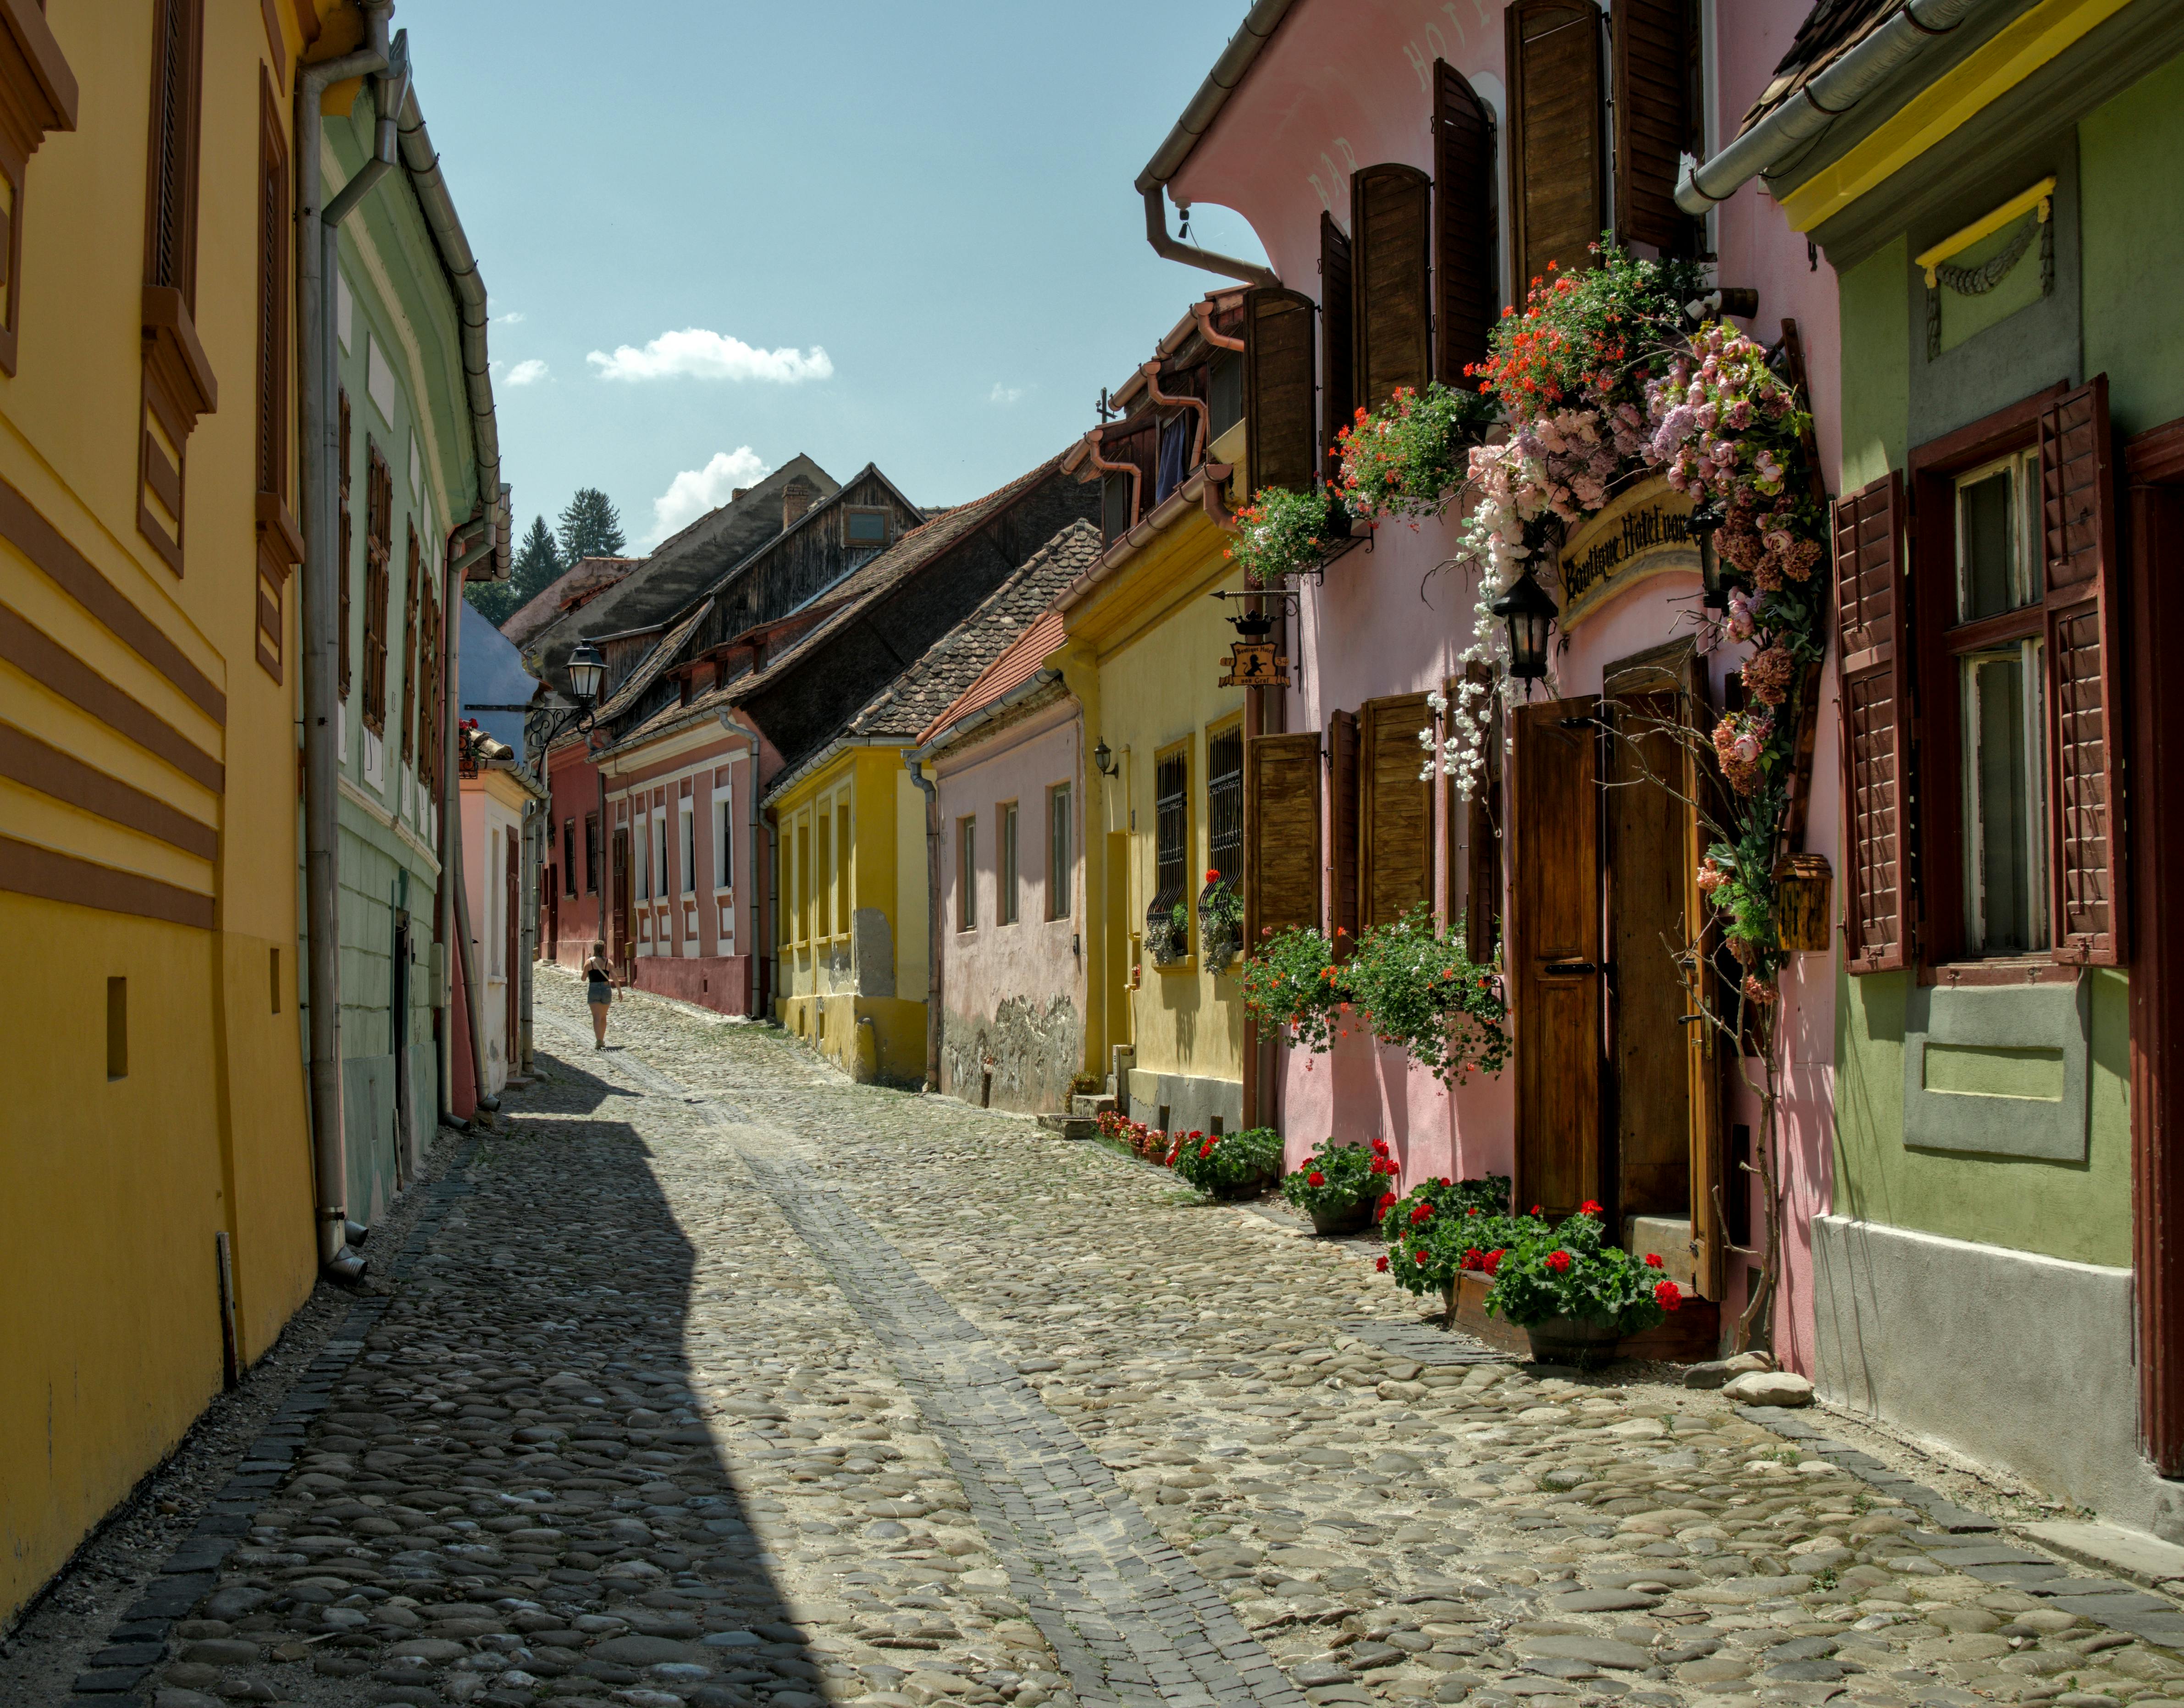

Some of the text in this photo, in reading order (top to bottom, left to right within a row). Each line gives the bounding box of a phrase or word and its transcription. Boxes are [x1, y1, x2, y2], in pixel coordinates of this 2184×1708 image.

[1403, 0, 1506, 94] HOTE
[1562, 536, 1621, 605] Boutique
[1620, 503, 1664, 560] Hotel
[1235, 647, 1259, 655] Boutique
